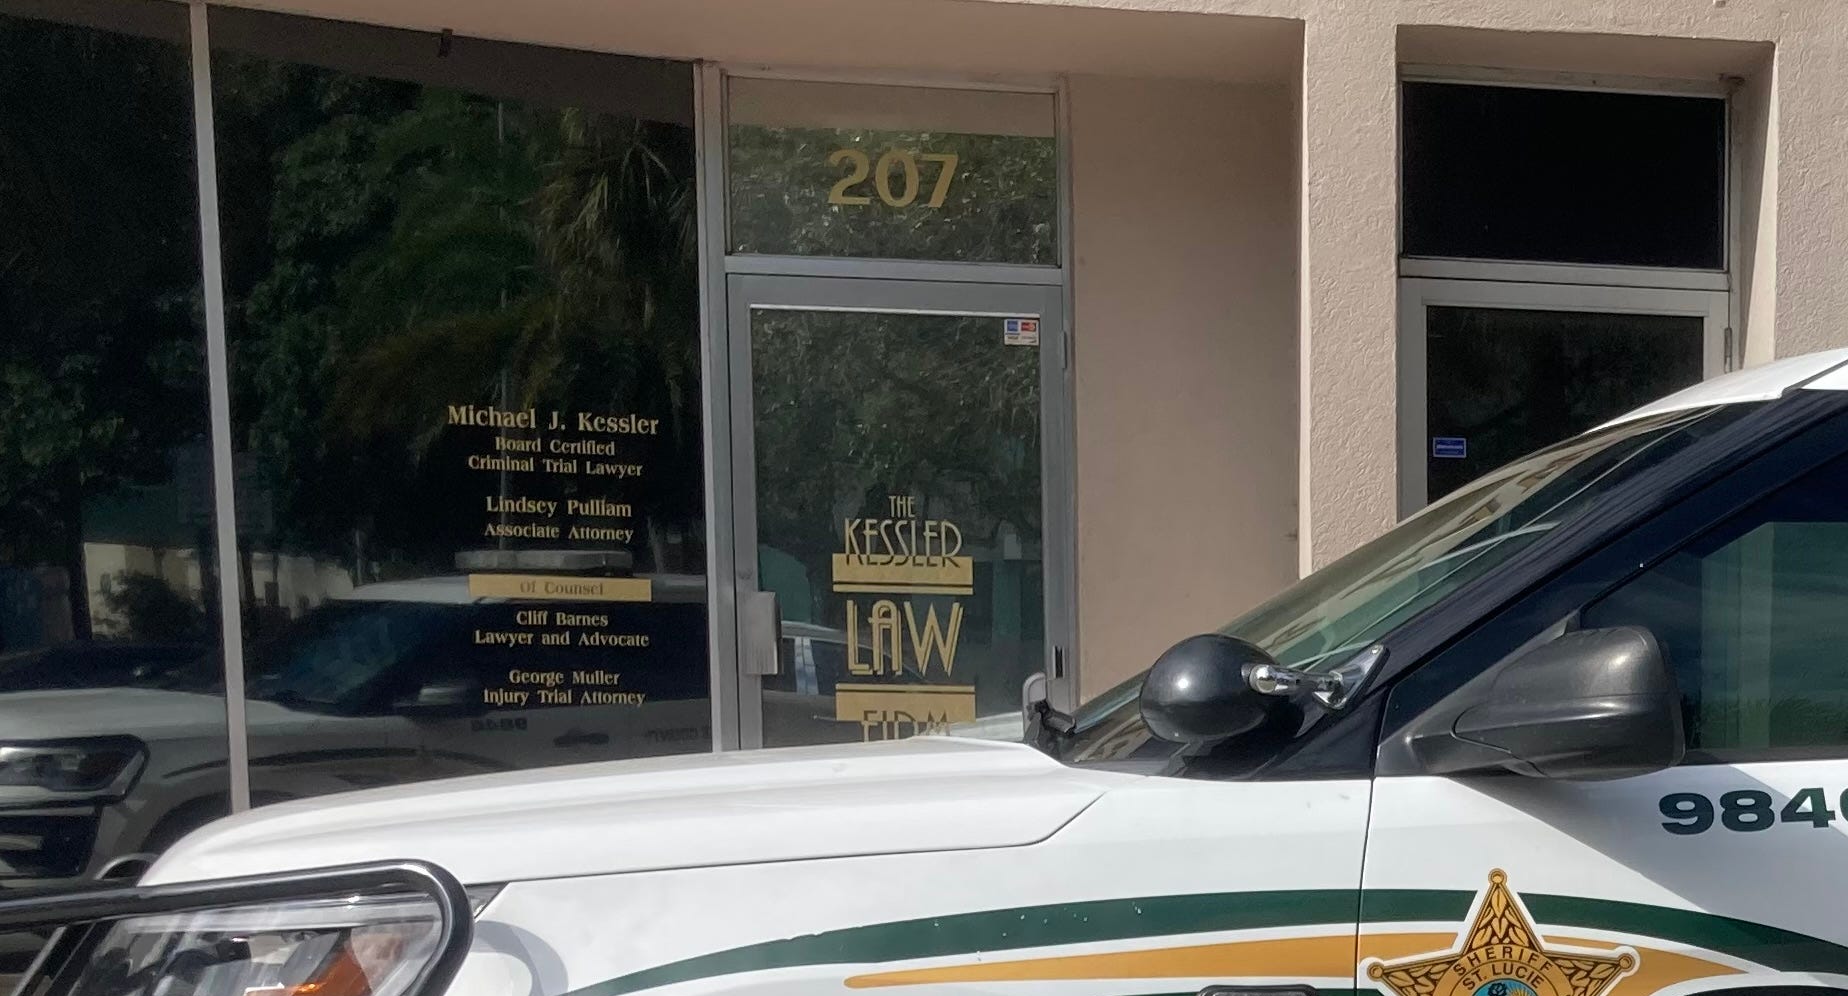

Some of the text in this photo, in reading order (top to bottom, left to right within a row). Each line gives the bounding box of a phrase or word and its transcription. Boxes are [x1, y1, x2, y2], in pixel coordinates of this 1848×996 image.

[827, 149, 959, 208] 207
[448, 405, 659, 435] Michael J. Kessler
[495, 436, 616, 457] Board Certified
[468, 455, 643, 478] Criminal Trial Lawyer
[486, 496, 632, 517] Lindsey Pulliam
[888, 495, 916, 518] THE
[484, 524, 634, 544] Associate Attorney
[844, 518, 963, 568] KESSLER
[520, 580, 605, 596] Of Counsel
[516, 611, 609, 626] Cliff Barnes
[475, 630, 649, 647] Lawyer and Advocate
[846, 599, 964, 677] LAW
[509, 669, 620, 686] George Muller
[483, 689, 646, 708] Injury Trial Attorney
[1453, 945, 1554, 976] SHERIFF
[1462, 963, 1545, 991] ST. LUCIE
